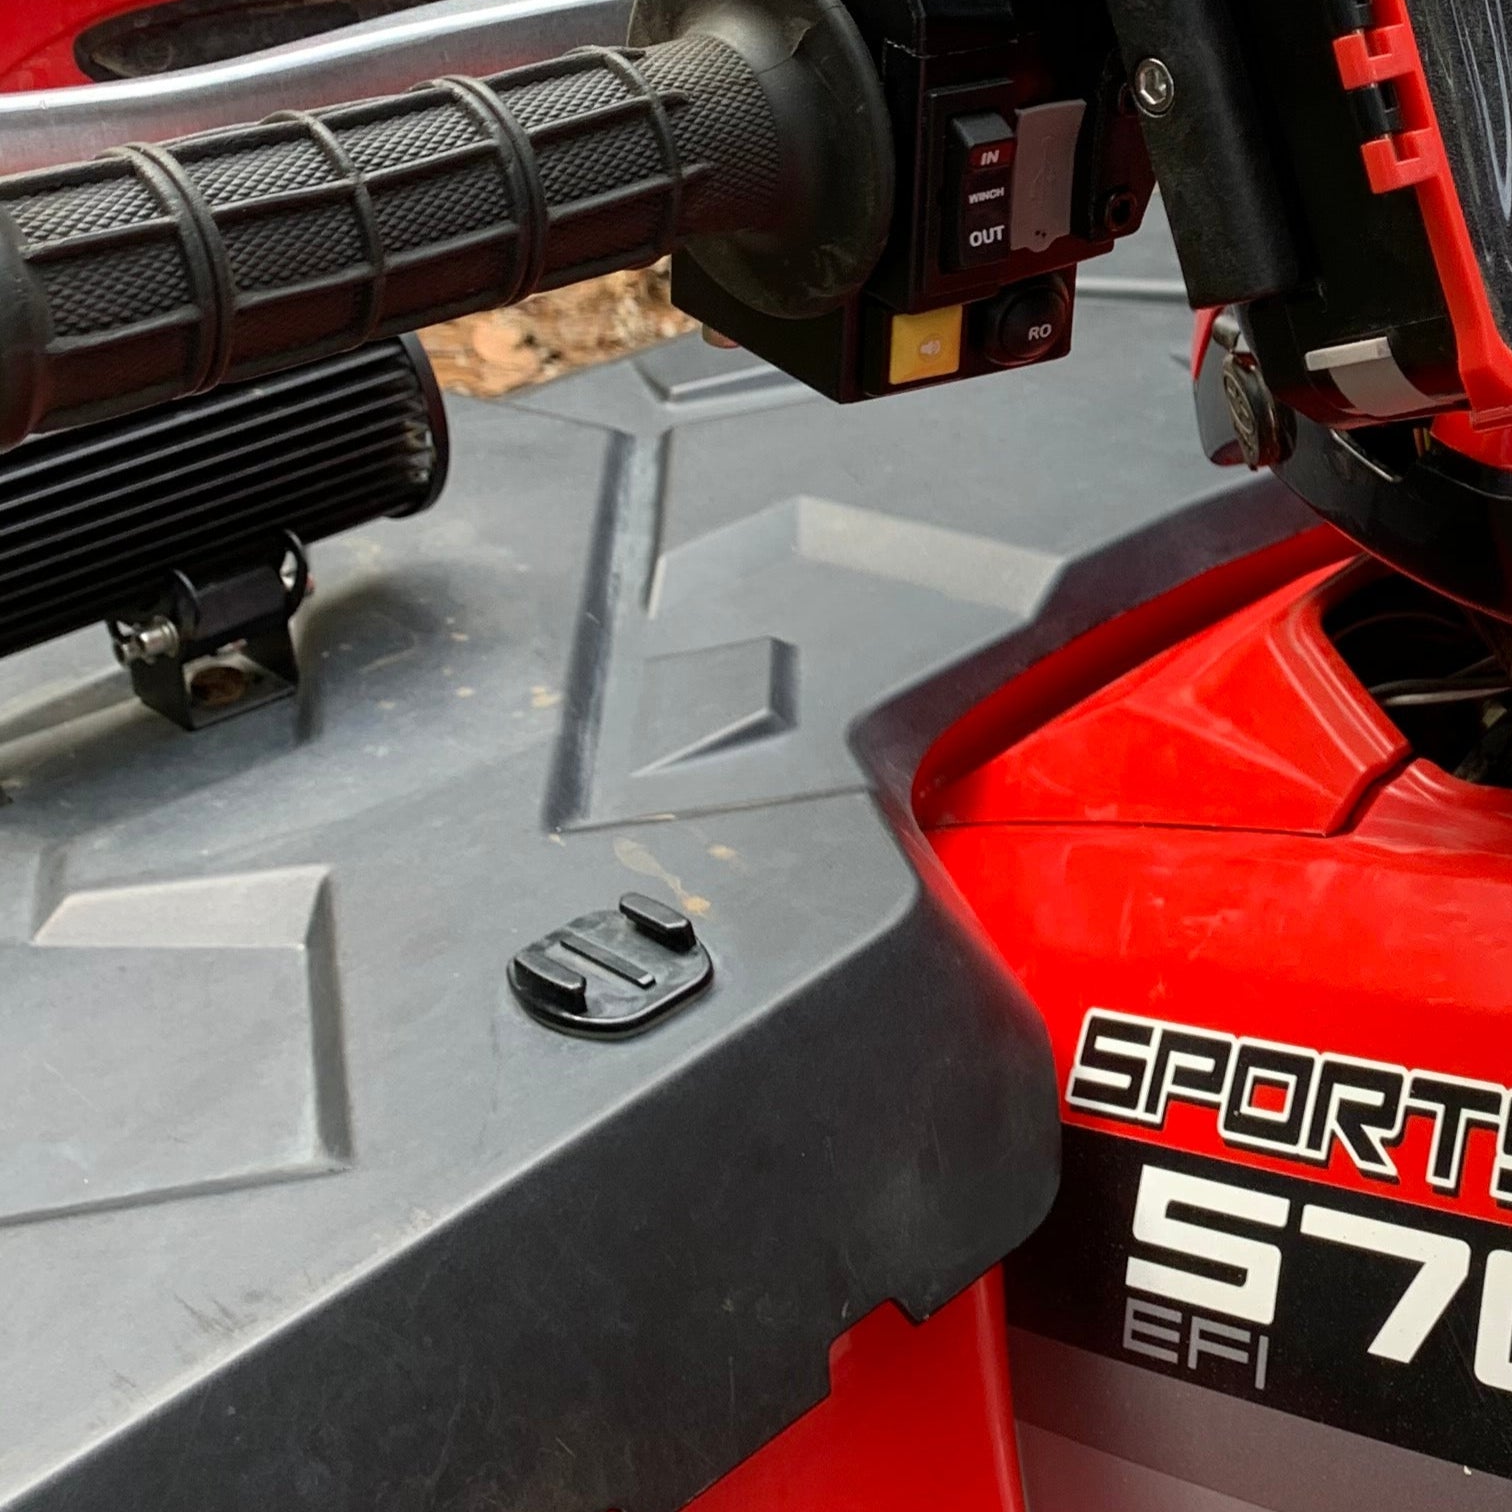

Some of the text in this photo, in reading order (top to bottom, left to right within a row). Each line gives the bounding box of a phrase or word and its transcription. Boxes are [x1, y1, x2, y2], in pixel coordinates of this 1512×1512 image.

[980, 150, 1000, 166] IN
[968, 187, 1005, 205] WINCH
[969, 225, 1006, 248] OUT
[1028, 323, 1052, 341] RO
[1122, 1297, 1269, 1390] EFI
